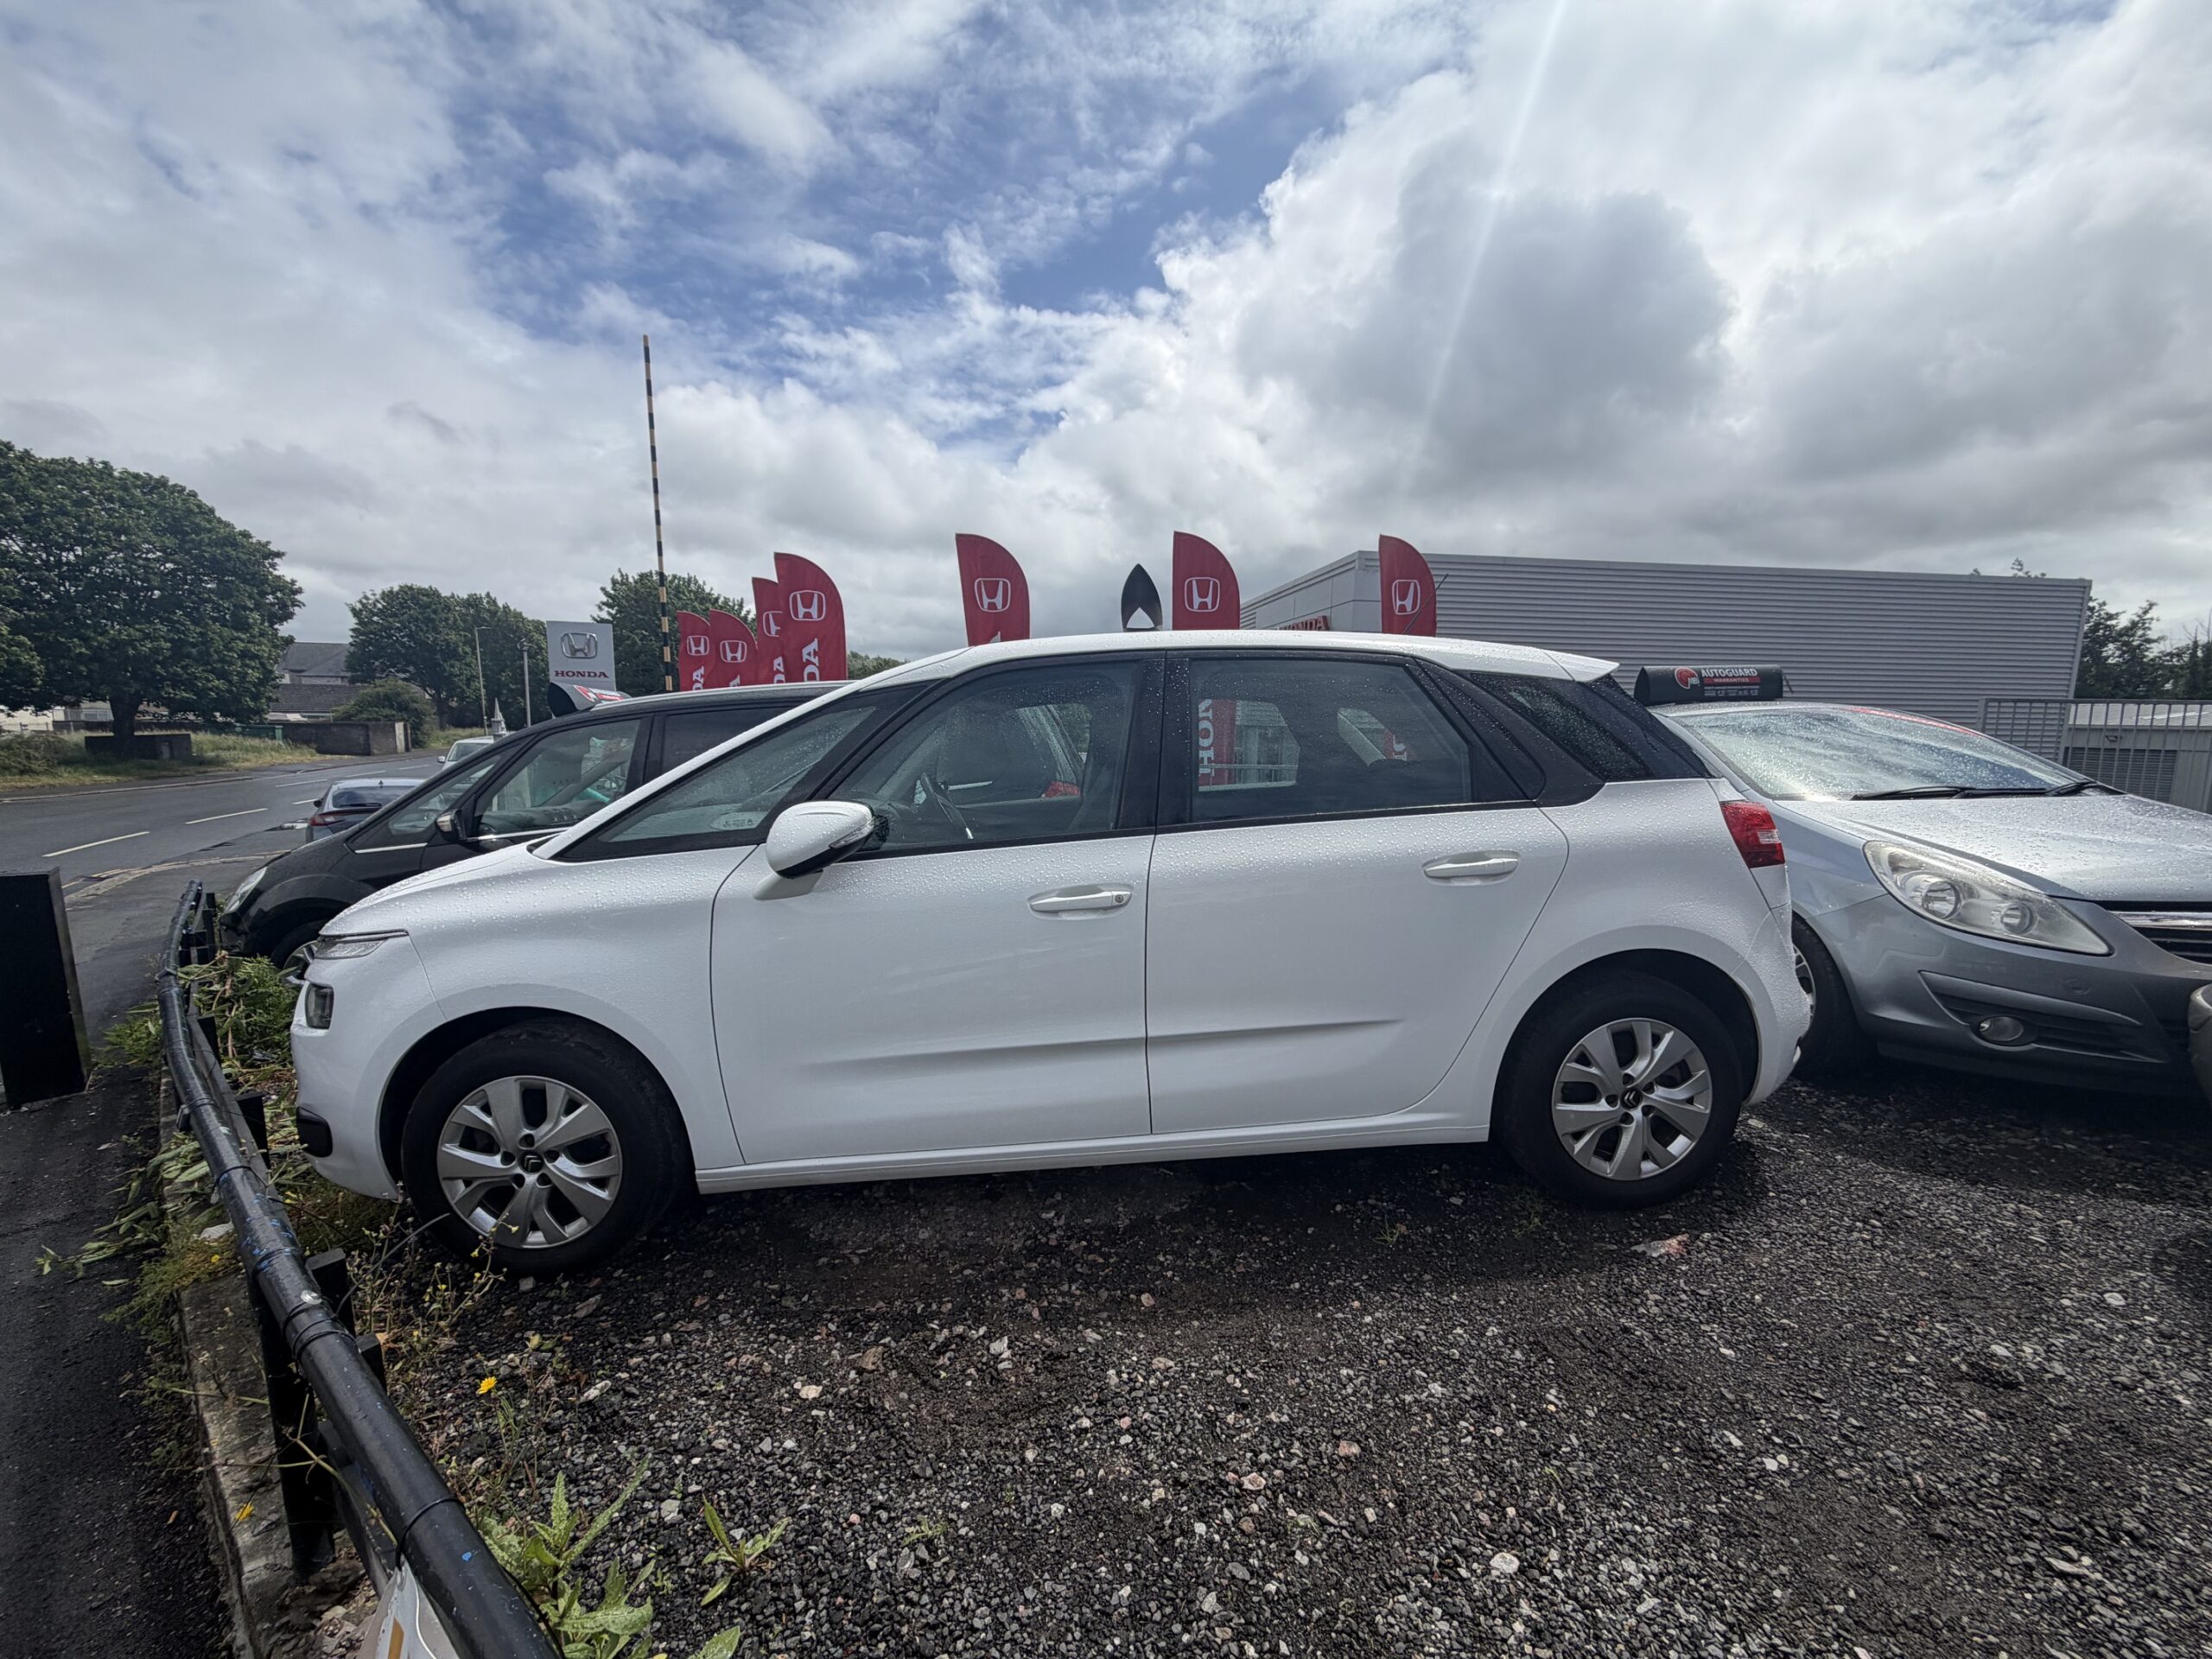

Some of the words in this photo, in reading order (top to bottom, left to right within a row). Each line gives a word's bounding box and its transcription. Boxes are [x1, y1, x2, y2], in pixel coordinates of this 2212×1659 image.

[554, 670, 609, 678] HONDA
[1701, 668, 1758, 677] AUTOGUARD
[1198, 698, 1215, 777] HON
